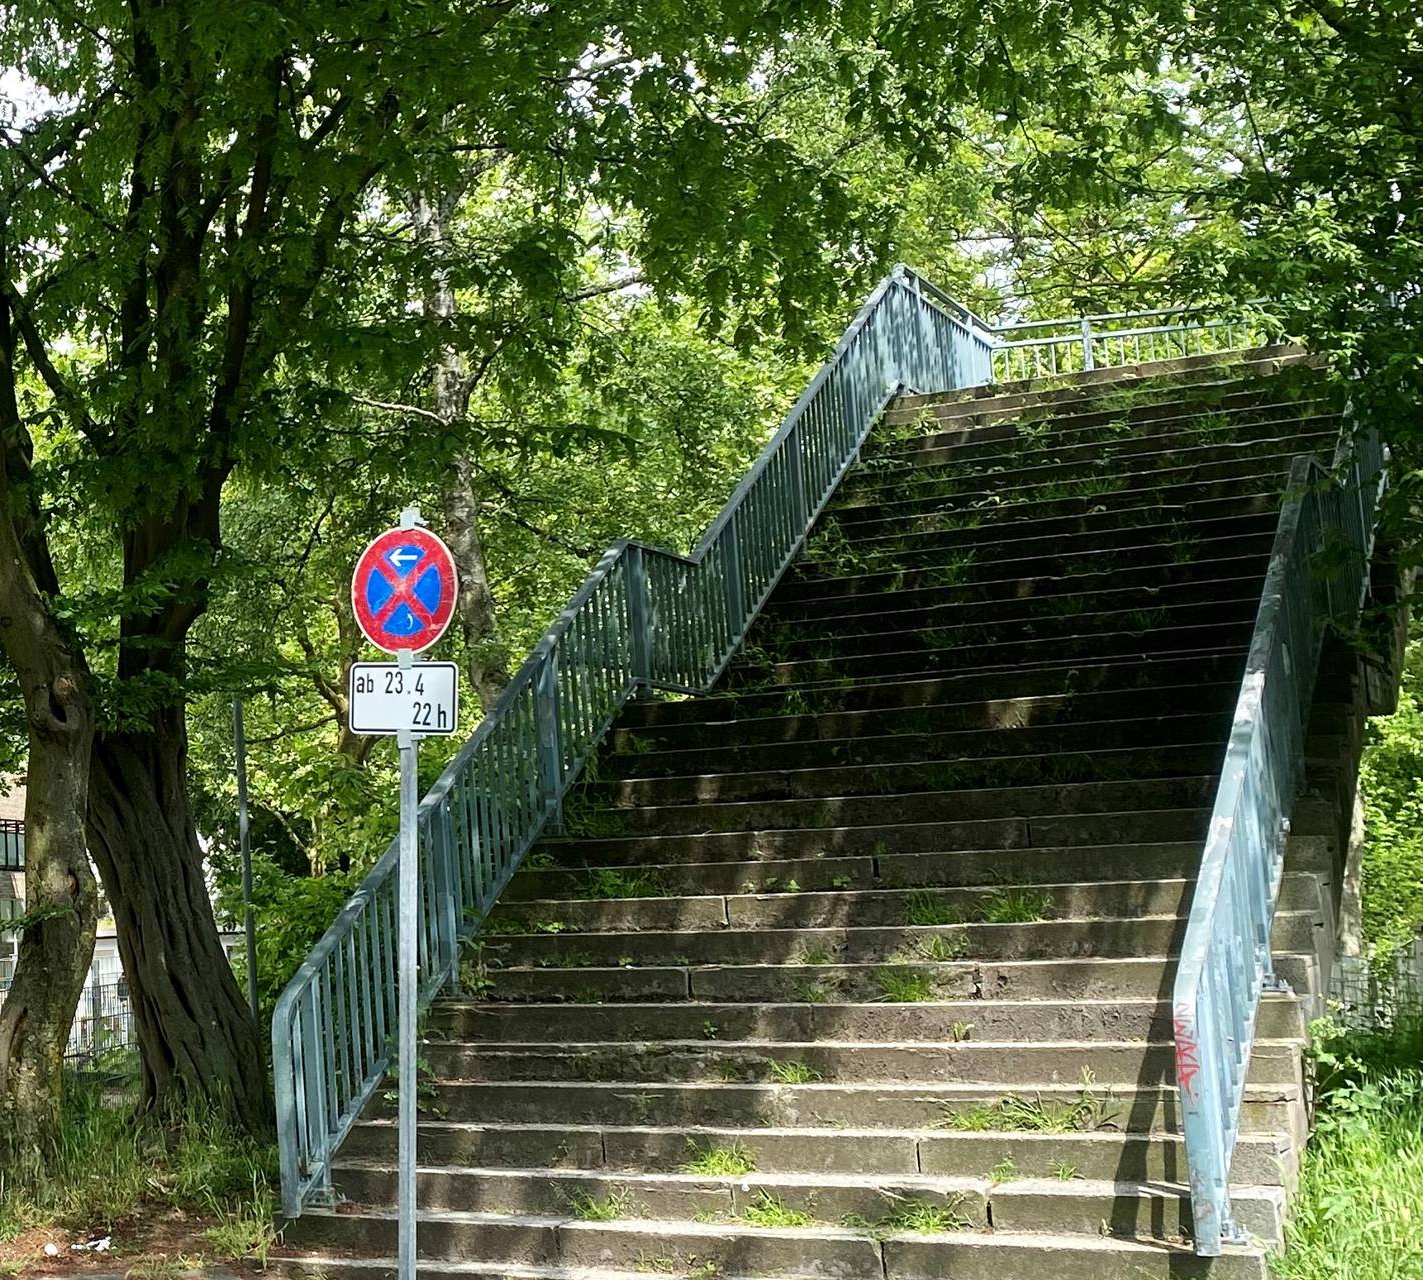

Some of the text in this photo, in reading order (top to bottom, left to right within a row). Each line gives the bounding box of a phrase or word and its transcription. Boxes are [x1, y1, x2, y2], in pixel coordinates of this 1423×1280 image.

[356, 671, 425, 696] ab 23.4
[412, 701, 447, 728] 22 h
